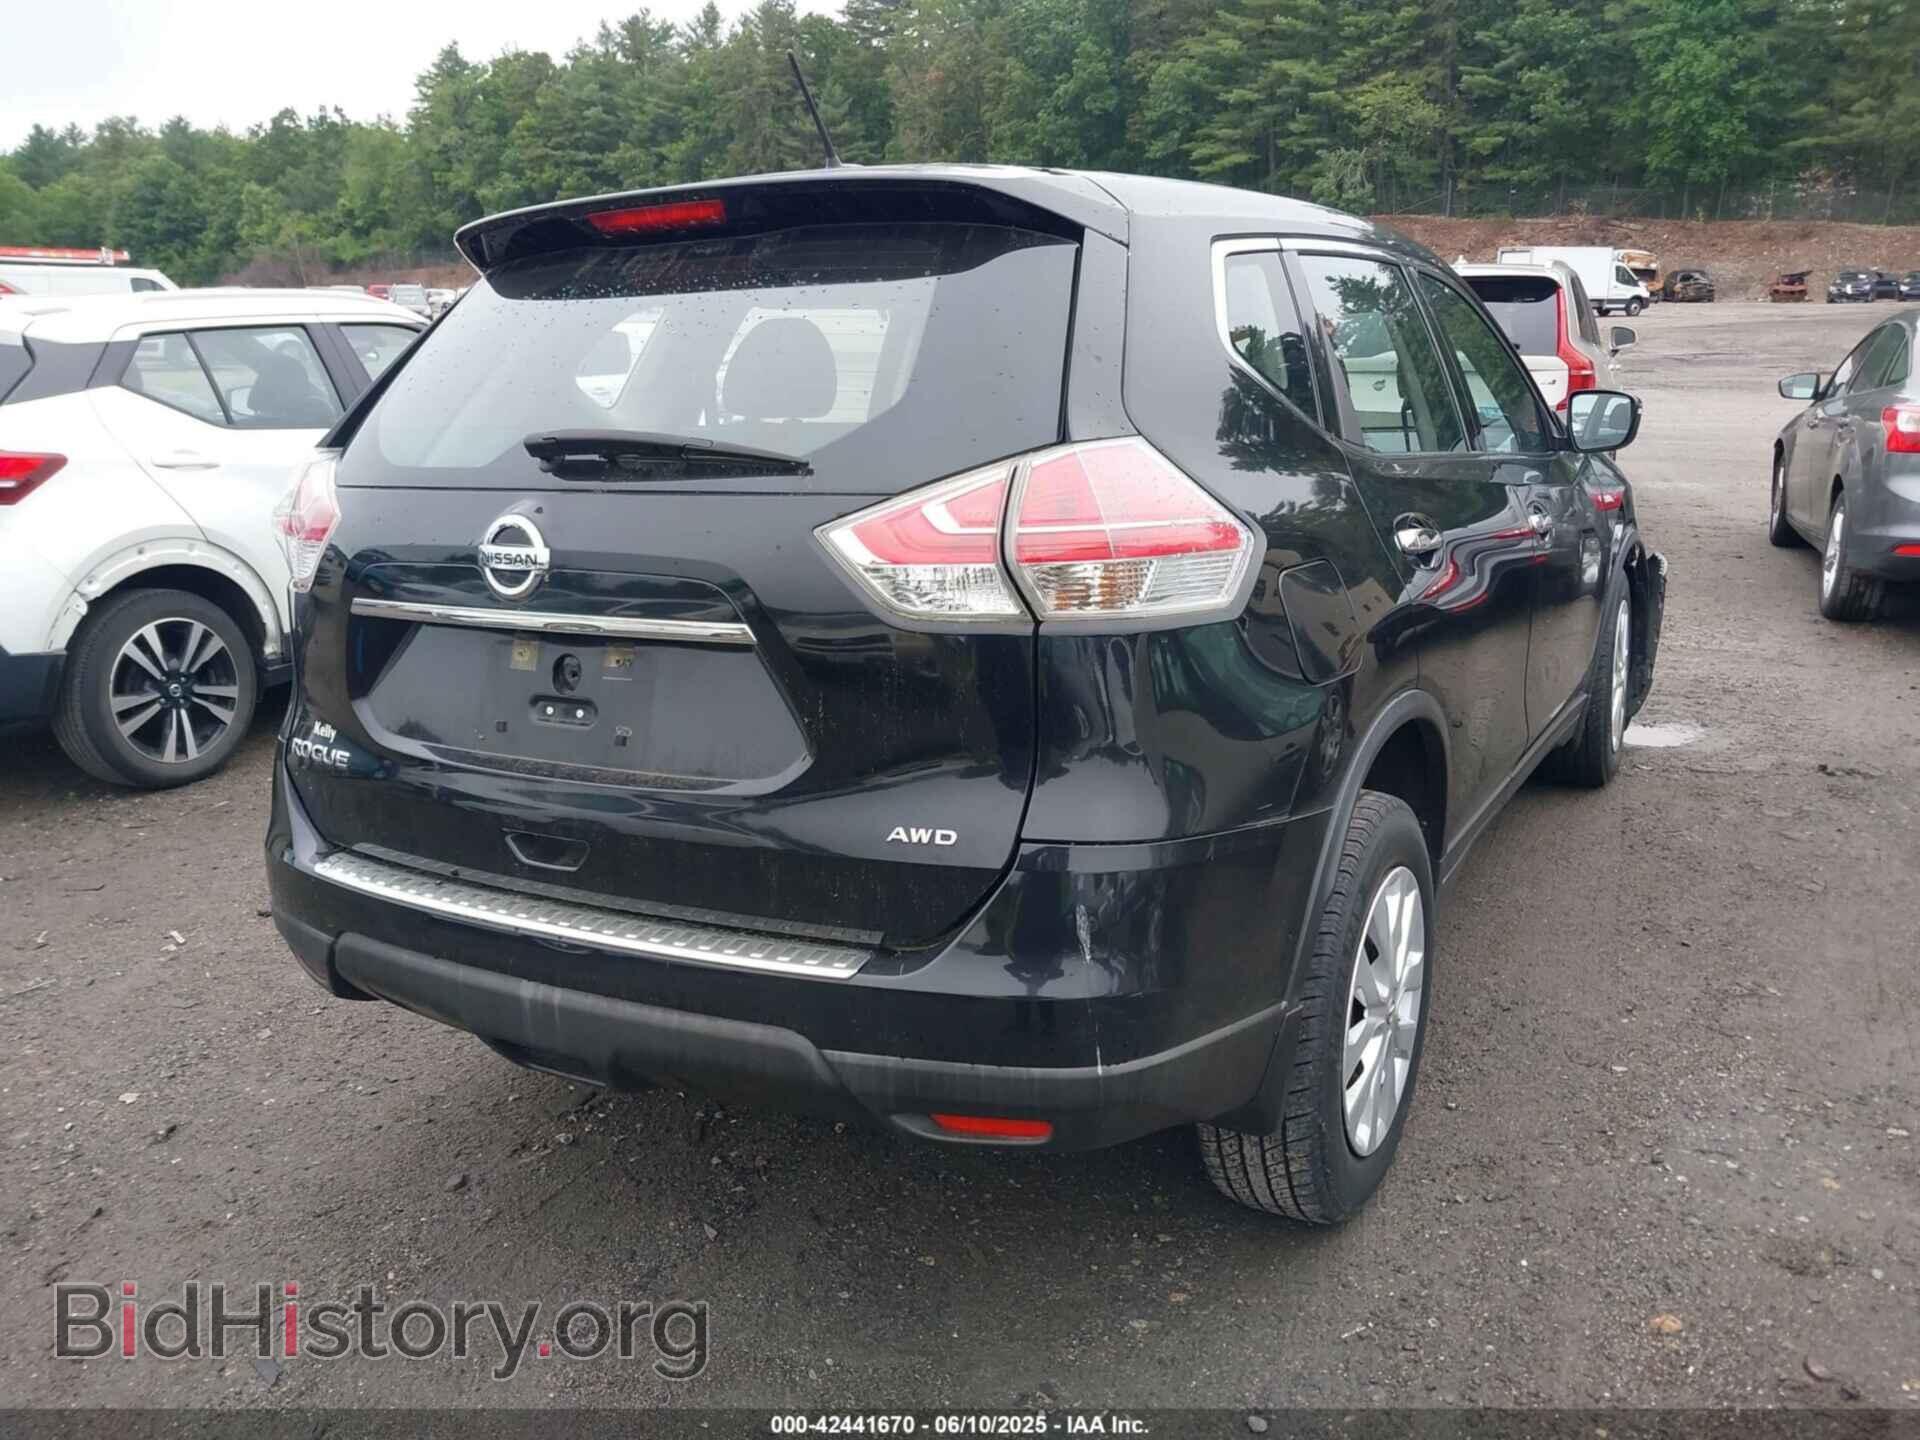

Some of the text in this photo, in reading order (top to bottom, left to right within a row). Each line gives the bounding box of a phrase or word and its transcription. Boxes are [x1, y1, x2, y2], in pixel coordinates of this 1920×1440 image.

[481, 552, 538, 566] NISSAN
[313, 720, 337, 744] Kelly
[291, 737, 351, 767] ROGUE
[885, 826, 958, 846] AWD
